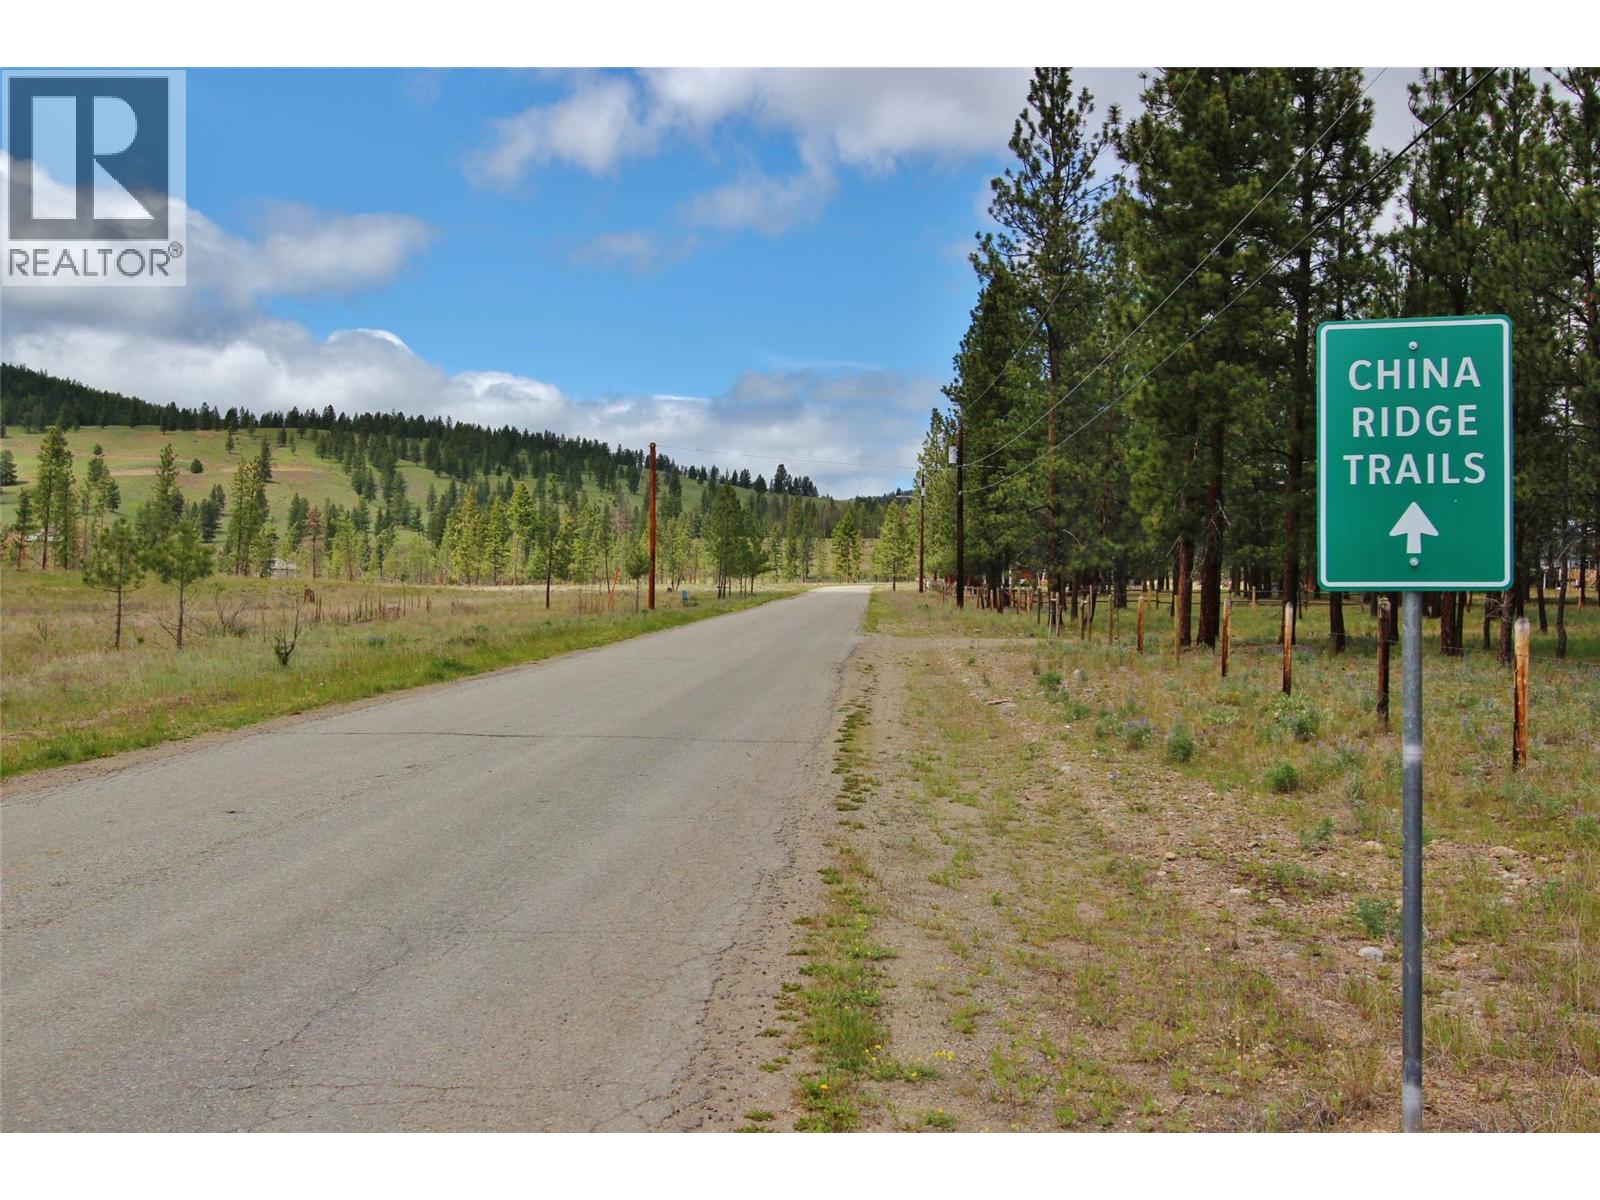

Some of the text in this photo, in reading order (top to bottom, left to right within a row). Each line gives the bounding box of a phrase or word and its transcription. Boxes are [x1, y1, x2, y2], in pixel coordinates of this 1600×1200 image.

[1348, 356, 1481, 391] CHINA
[1352, 404, 1478, 438] RIDGE
[1343, 452, 1486, 485] TRAILS
